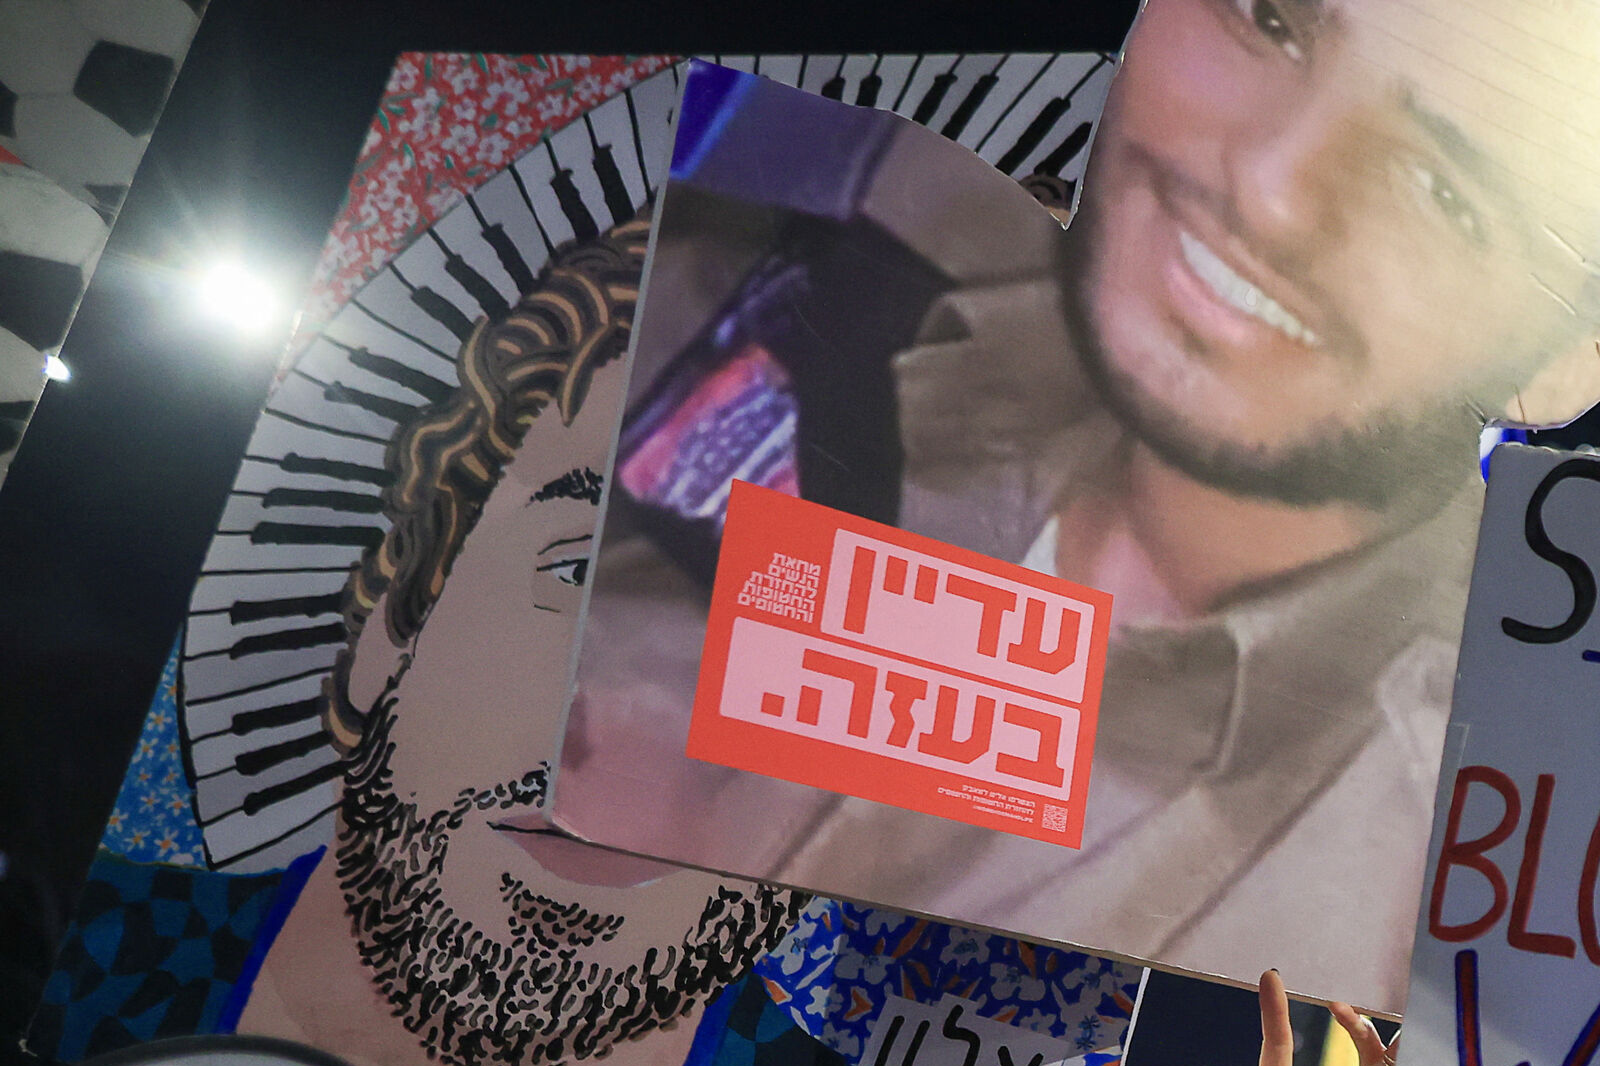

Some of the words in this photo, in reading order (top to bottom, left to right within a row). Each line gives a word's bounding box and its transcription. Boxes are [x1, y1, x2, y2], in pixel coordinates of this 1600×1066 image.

[768, 563, 819, 588] הנשים
[773, 552, 821, 576] מחאת
[742, 580, 816, 612] החטופות
[750, 571, 817, 599] להחזרת
[737, 592, 814, 624] והחטופים
[843, 545, 1082, 675] עדיין
[760, 648, 1065, 788] בעזה.
